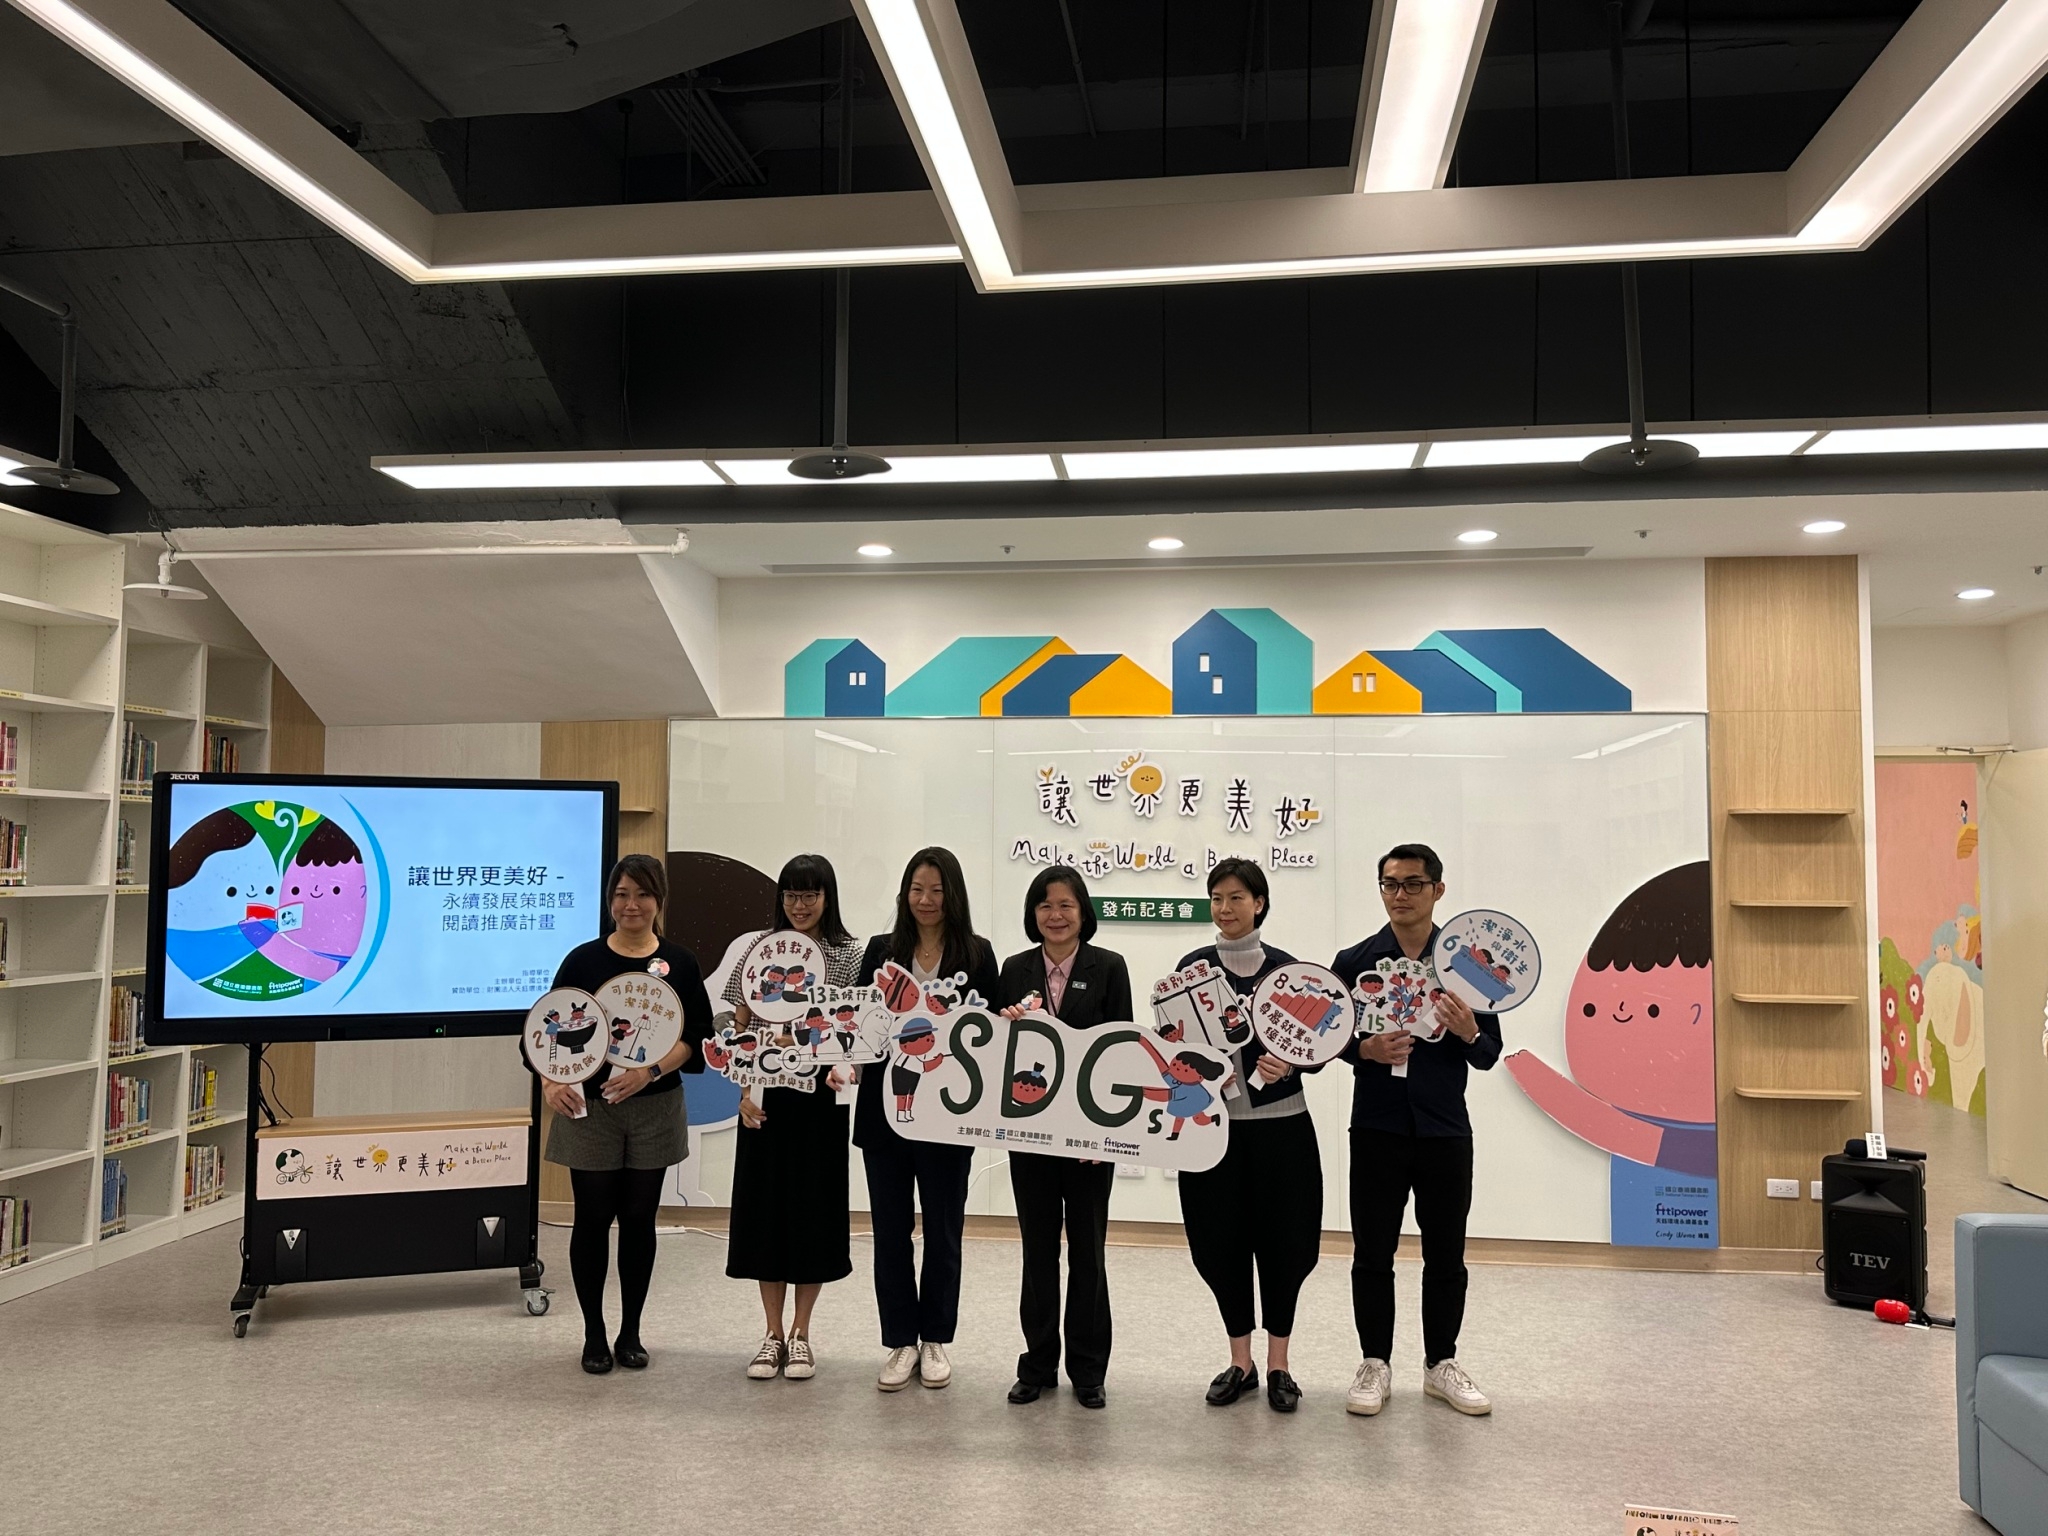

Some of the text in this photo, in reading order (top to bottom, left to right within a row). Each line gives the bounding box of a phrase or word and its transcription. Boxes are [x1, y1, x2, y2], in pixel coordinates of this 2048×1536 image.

[1038, 765, 1319, 836] 讓世界更美好
[1012, 840, 1075, 867] Make
[1082, 852, 1110, 877] the
[1183, 863, 1195, 877] a
[408, 865, 548, 887] 讓世界更美好
[442, 892, 575, 910] 永續發展策略暨
[1102, 901, 1194, 918] 發布記者會
[442, 913, 556, 932] 閱讀推廣計畫
[1442, 935, 1461, 951] 6
[1480, 919, 1527, 953] 潔淨水
[759, 940, 813, 962] 優質教育
[1490, 941, 1529, 976] 與衛生
[746, 966, 757, 983] 4
[1156, 963, 1210, 994] 性別平等
[1379, 960, 1436, 980] 陸域生命
[611, 981, 662, 999] 可負擔的
[1274, 973, 1289, 990] 8
[809, 986, 827, 1004] 13
[829, 989, 883, 1003] 氣候行動
[1198, 991, 1214, 1012] 5
[624, 997, 676, 1022] 潔淨能源
[1260, 1002, 1312, 1044] 尊嚴就業與
[1367, 1014, 1385, 1032] 15
[533, 1030, 544, 1049] 2
[758, 1030, 774, 1047] 12
[1263, 1026, 1315, 1062] 經濟成長
[548, 1053, 596, 1076] 消除飢餓
[732, 1070, 814, 1091] 負責任的消費與生產
[325, 1149, 457, 1182] 讓世界更美好
[1656, 1231, 1673, 1240] Cindy
[1850, 1252, 1890, 1270] TEV
